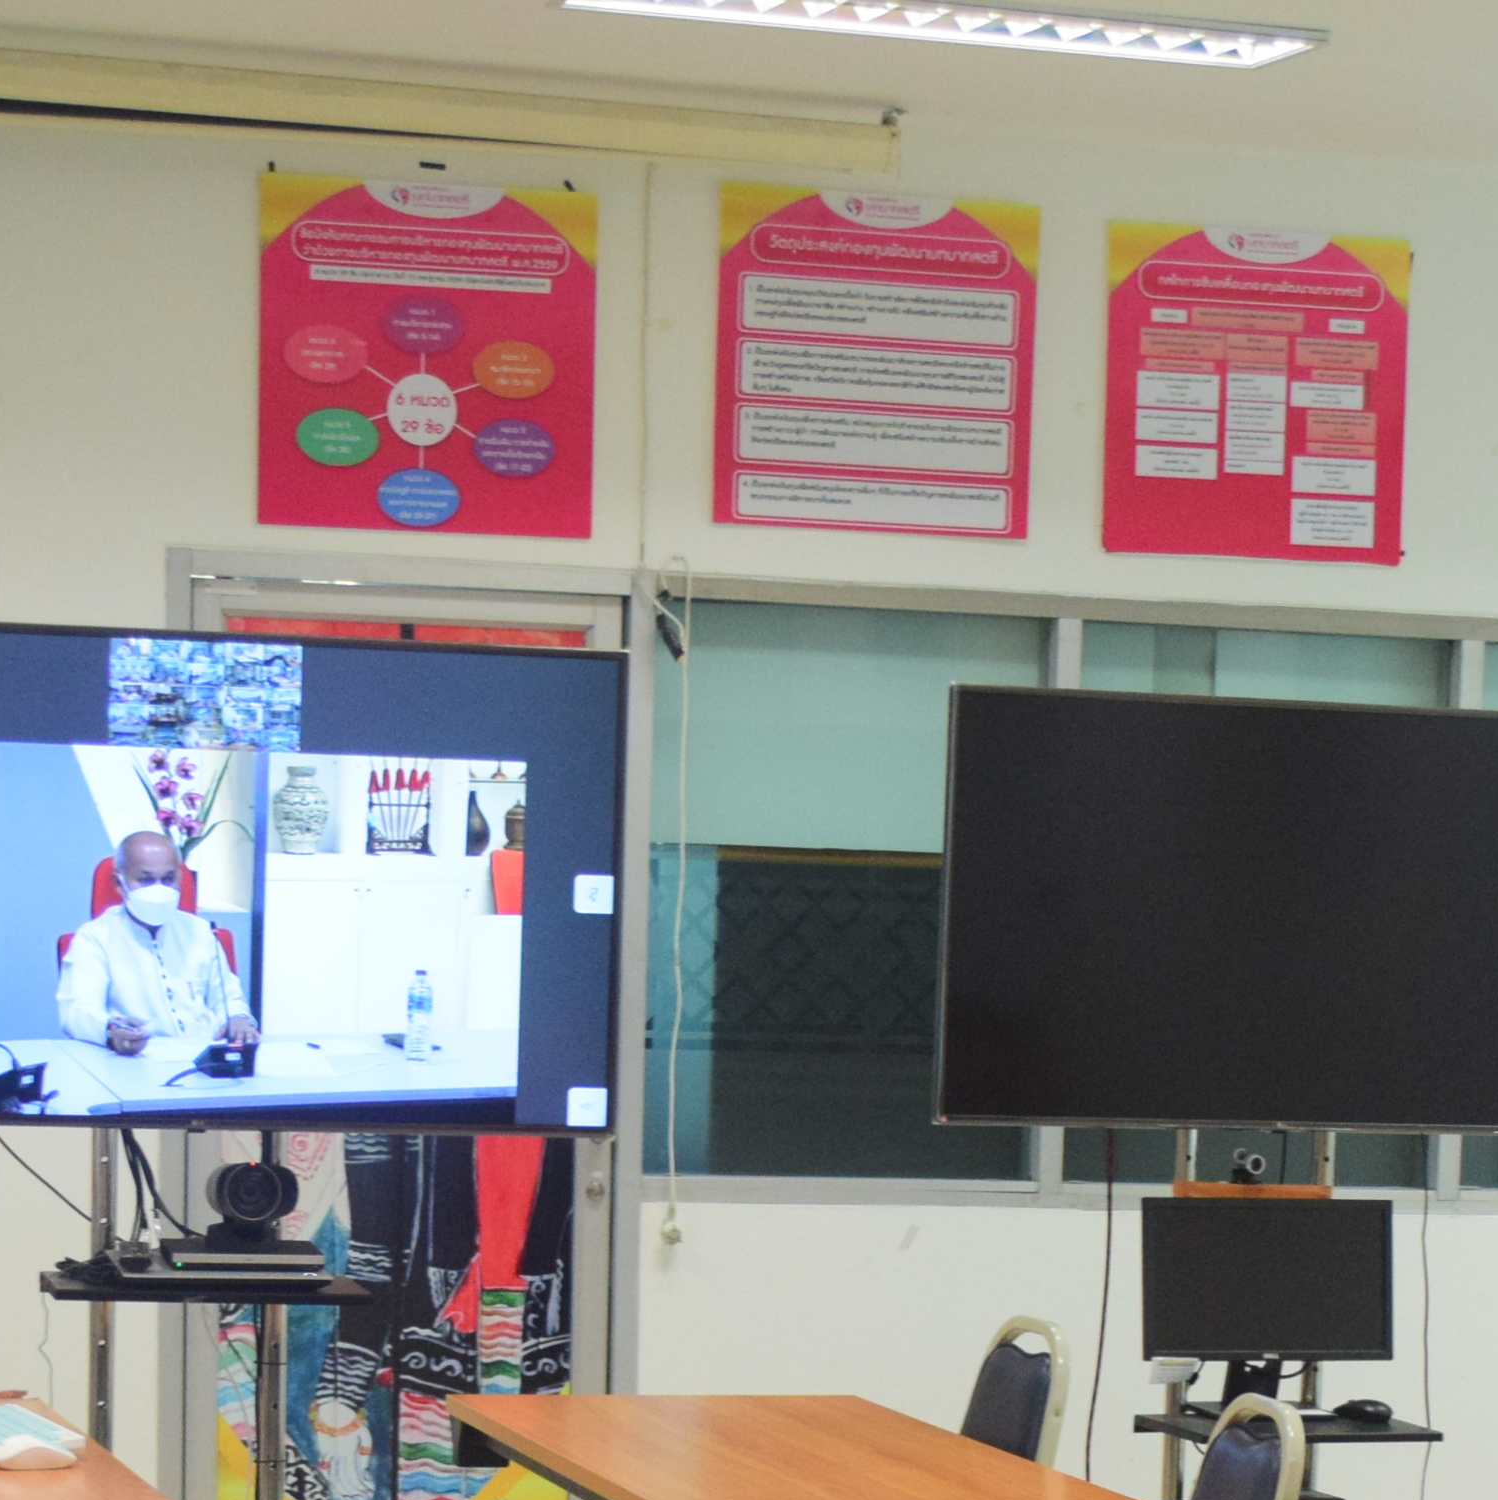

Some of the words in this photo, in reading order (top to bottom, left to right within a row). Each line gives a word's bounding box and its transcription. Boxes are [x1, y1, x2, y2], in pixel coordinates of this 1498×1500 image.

[396, 396, 405, 405] 6
[411, 396, 450, 408] หมวด
[402, 421, 418, 434] 29
